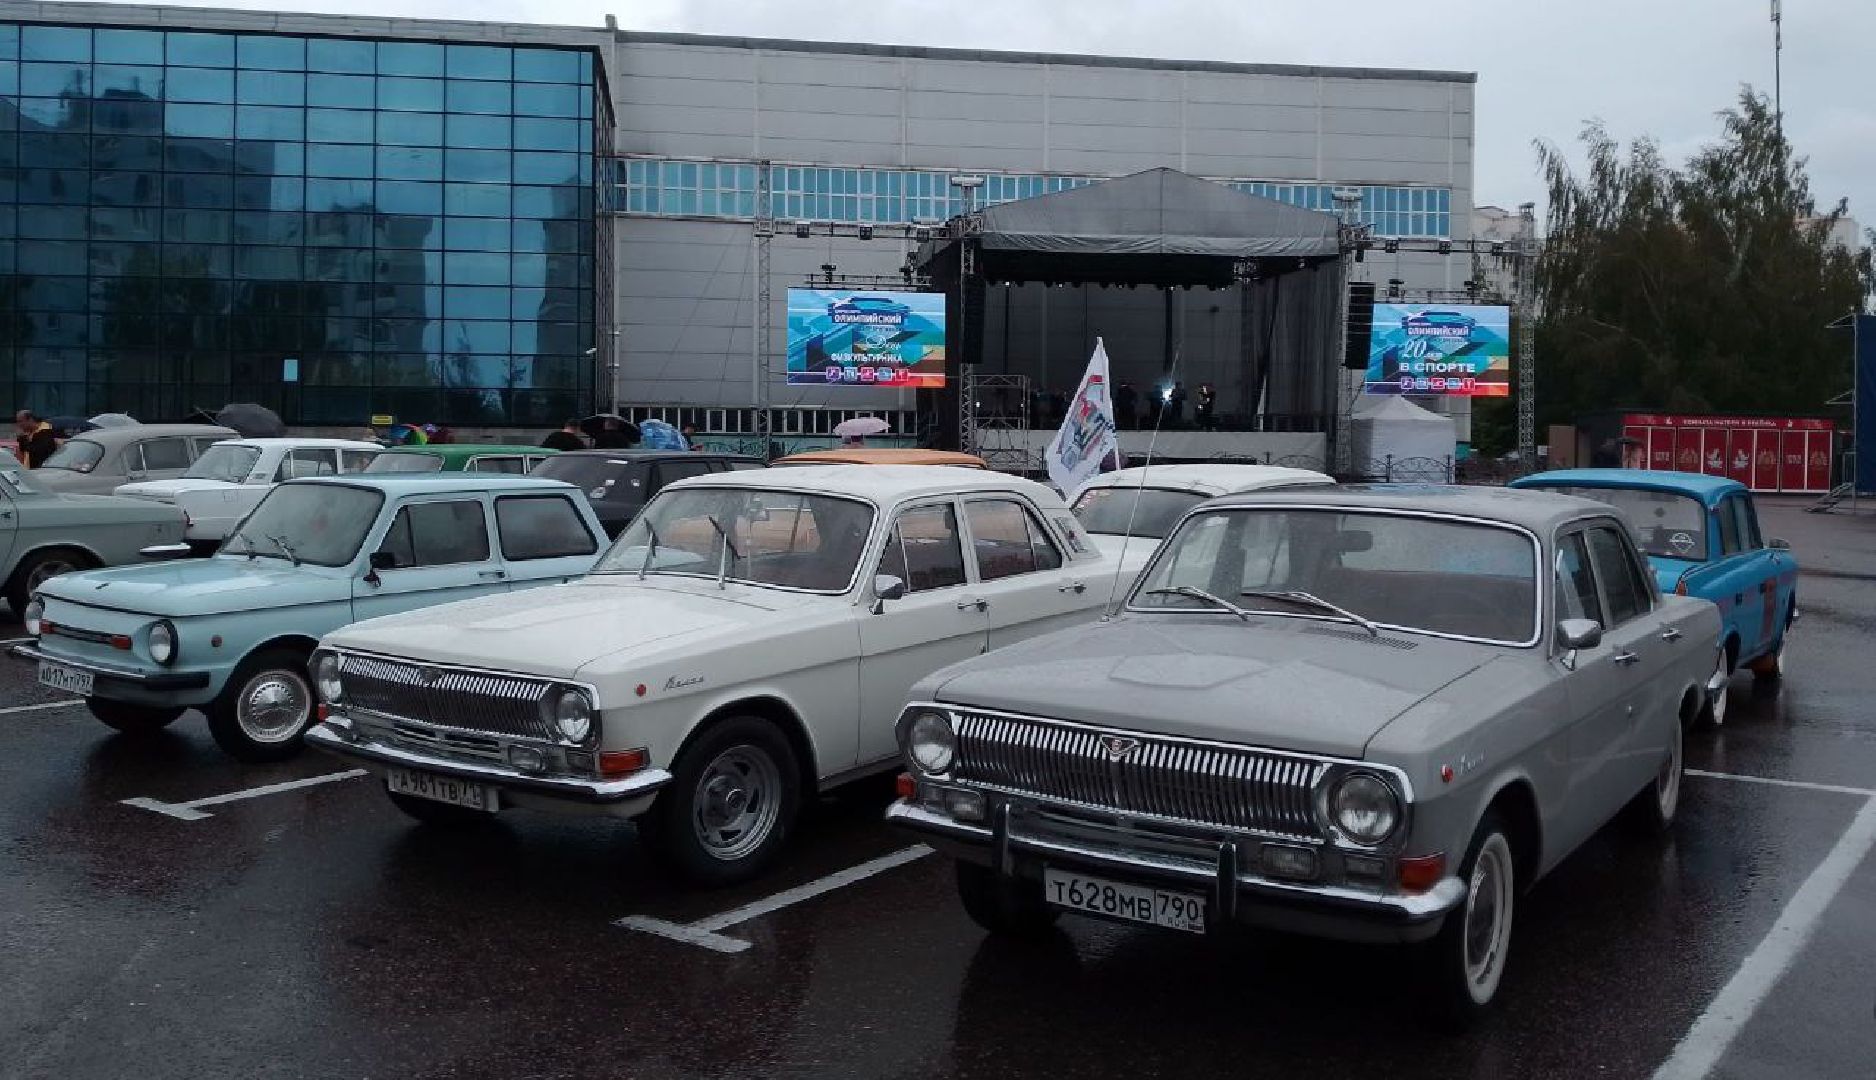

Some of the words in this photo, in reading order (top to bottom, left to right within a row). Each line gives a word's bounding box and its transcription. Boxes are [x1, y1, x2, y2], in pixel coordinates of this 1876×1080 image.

[834, 312, 902, 324] ОЛИМПИЙСКИЙ
[1407, 325, 1469, 336] ОЛИМПИЙСКИЙ
[1400, 362, 1409, 372] В
[1414, 362, 1476, 373] СПОРТЕ
[1157, 894, 1199, 921] 790
